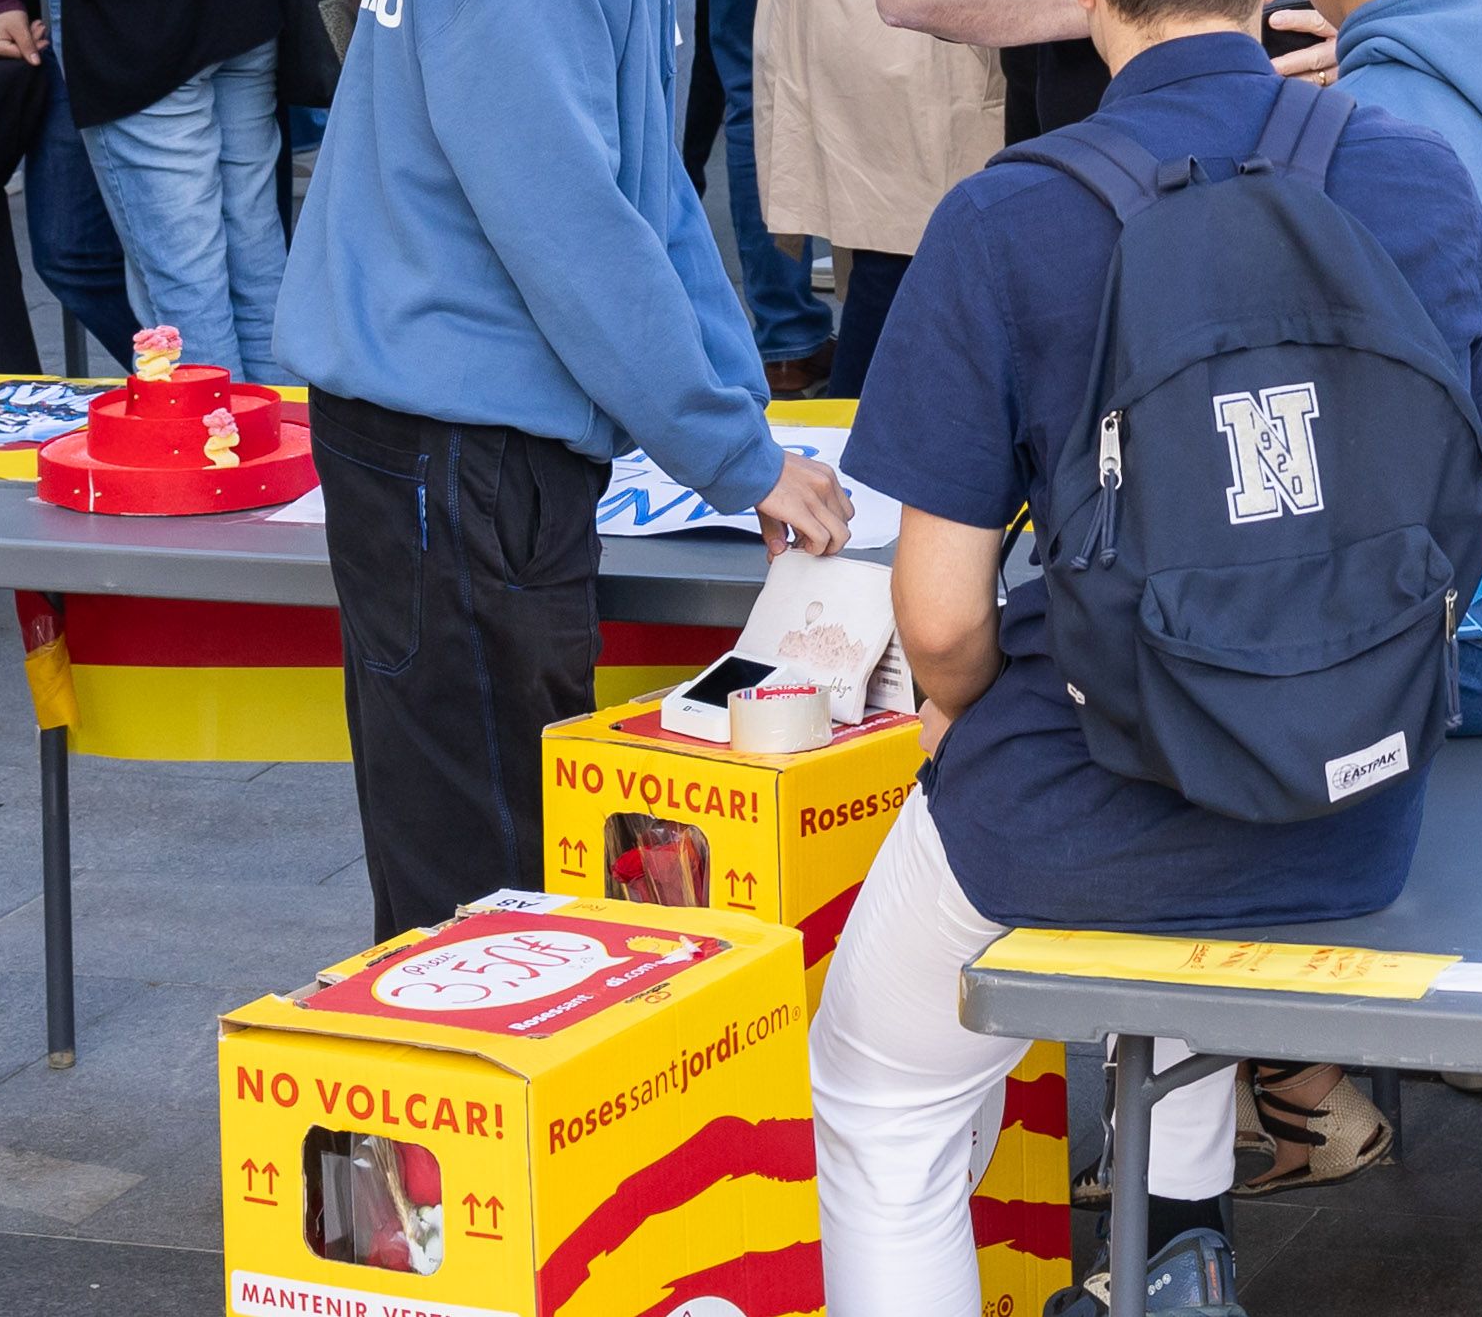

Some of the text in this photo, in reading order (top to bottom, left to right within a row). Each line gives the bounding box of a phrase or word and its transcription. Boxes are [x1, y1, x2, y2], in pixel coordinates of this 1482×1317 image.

[1213, 382, 1324, 525] N
[555, 757, 759, 823] NO VOLCAR!
[1343, 750, 1397, 783] EASTPAK
[236, 1066, 504, 1140] NO VOLCAR!
[241, 1282, 368, 1317] MANTENIR
